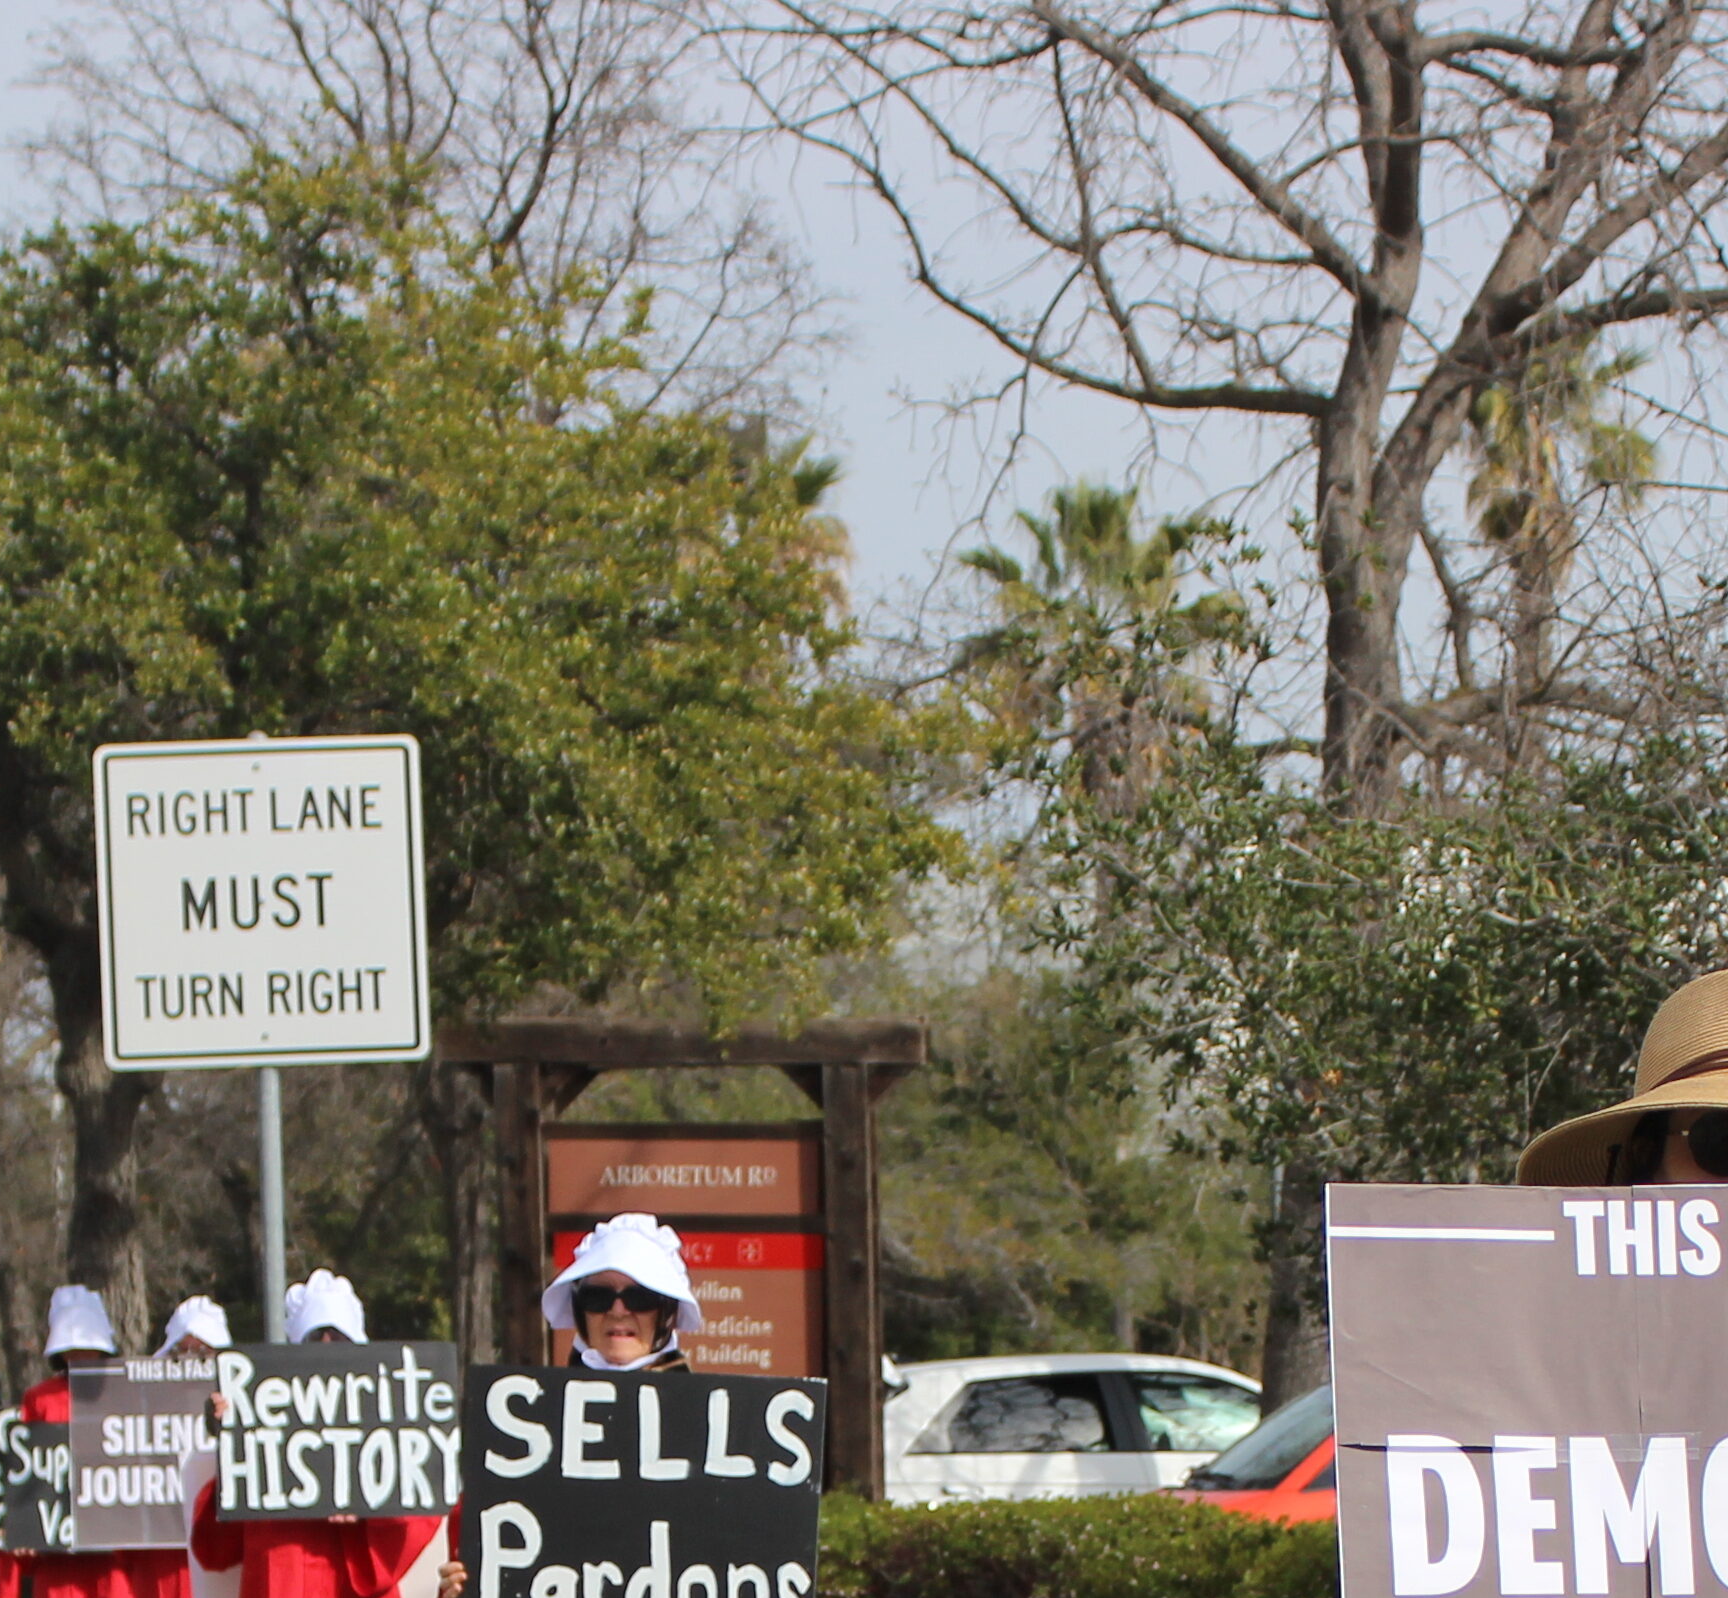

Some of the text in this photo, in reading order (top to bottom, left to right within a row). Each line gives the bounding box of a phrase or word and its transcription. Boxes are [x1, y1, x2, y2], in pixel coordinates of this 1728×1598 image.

[127, 784, 382, 837] RIGHT LANE
[182, 872, 333, 931] MUST
[136, 967, 386, 1019] TURN RIGHT
[600, 1165, 742, 1187] ARBORETUM
[1563, 1199, 1721, 1276] THIS
[125, 1360, 165, 1382] THIS
[166, 1360, 183, 1381] IS
[697, 1344, 770, 1369] Building
[217, 1344, 455, 1428] Rewrite
[484, 1374, 816, 1486] SELLS
[218, 1424, 462, 1510] HISTORY
